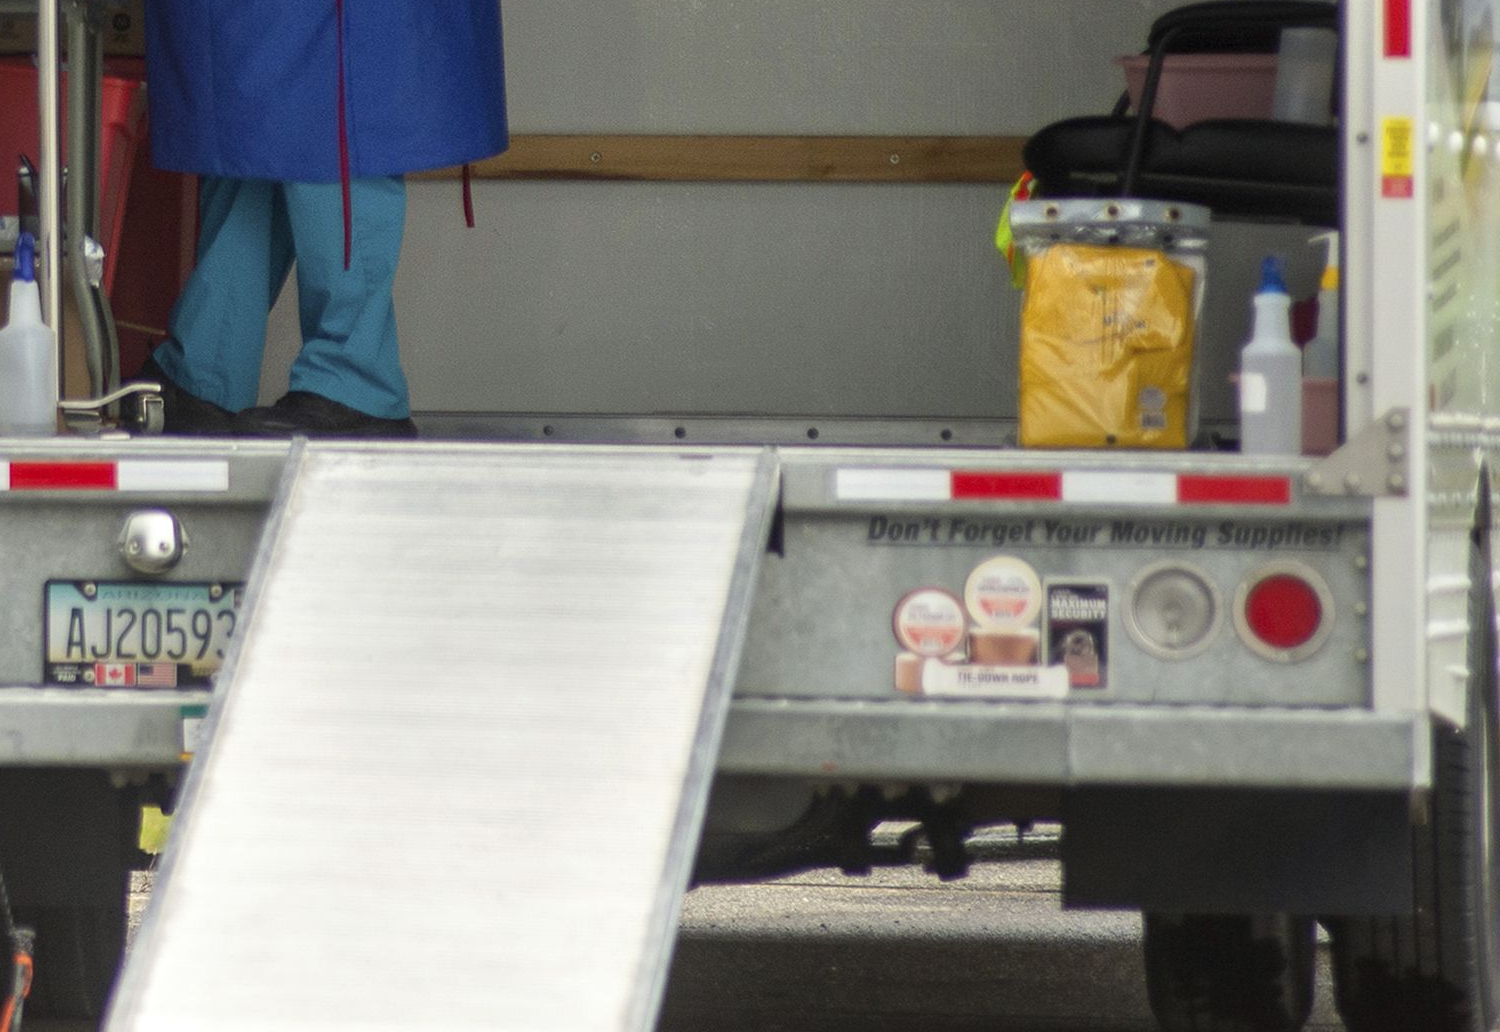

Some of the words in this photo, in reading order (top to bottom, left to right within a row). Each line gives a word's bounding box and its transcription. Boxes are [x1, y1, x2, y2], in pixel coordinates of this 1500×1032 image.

[868, 515, 941, 542] Don't
[948, 518, 1035, 546] Forget
[1043, 520, 1104, 543] Your
[1110, 520, 1208, 549] Moving
[1217, 520, 1349, 549] Supplies!
[1051, 599, 1106, 609] MAXIMUM
[1051, 608, 1106, 619] SECURITY
[957, 671, 1010, 683] TIE-DOWN
